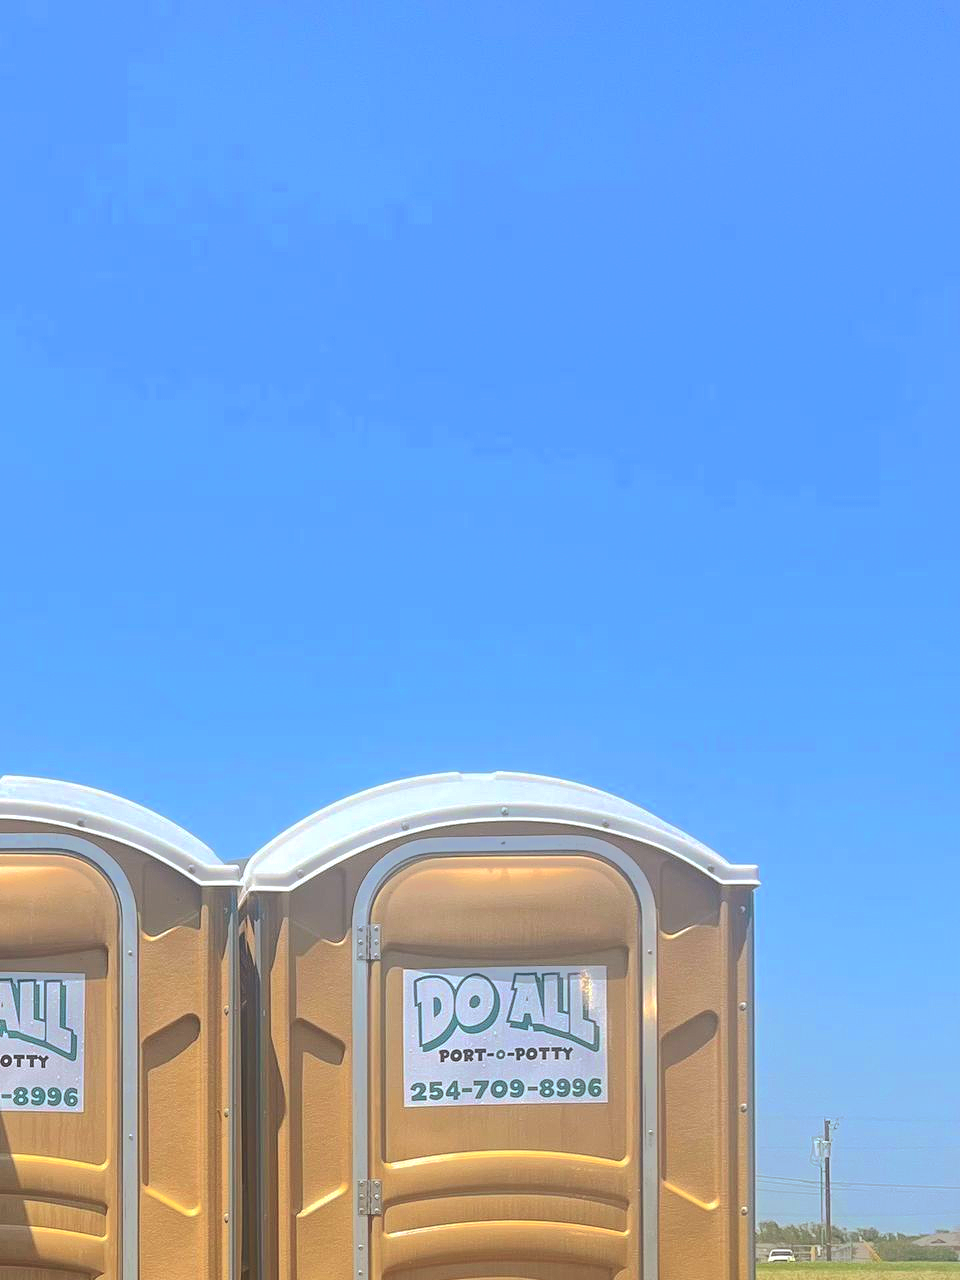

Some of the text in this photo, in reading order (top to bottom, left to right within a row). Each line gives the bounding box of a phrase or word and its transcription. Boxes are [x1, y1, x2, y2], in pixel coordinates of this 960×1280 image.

[414, 972, 599, 1052] DO ALL
[410, 1078, 602, 1101] 254-709-8996
